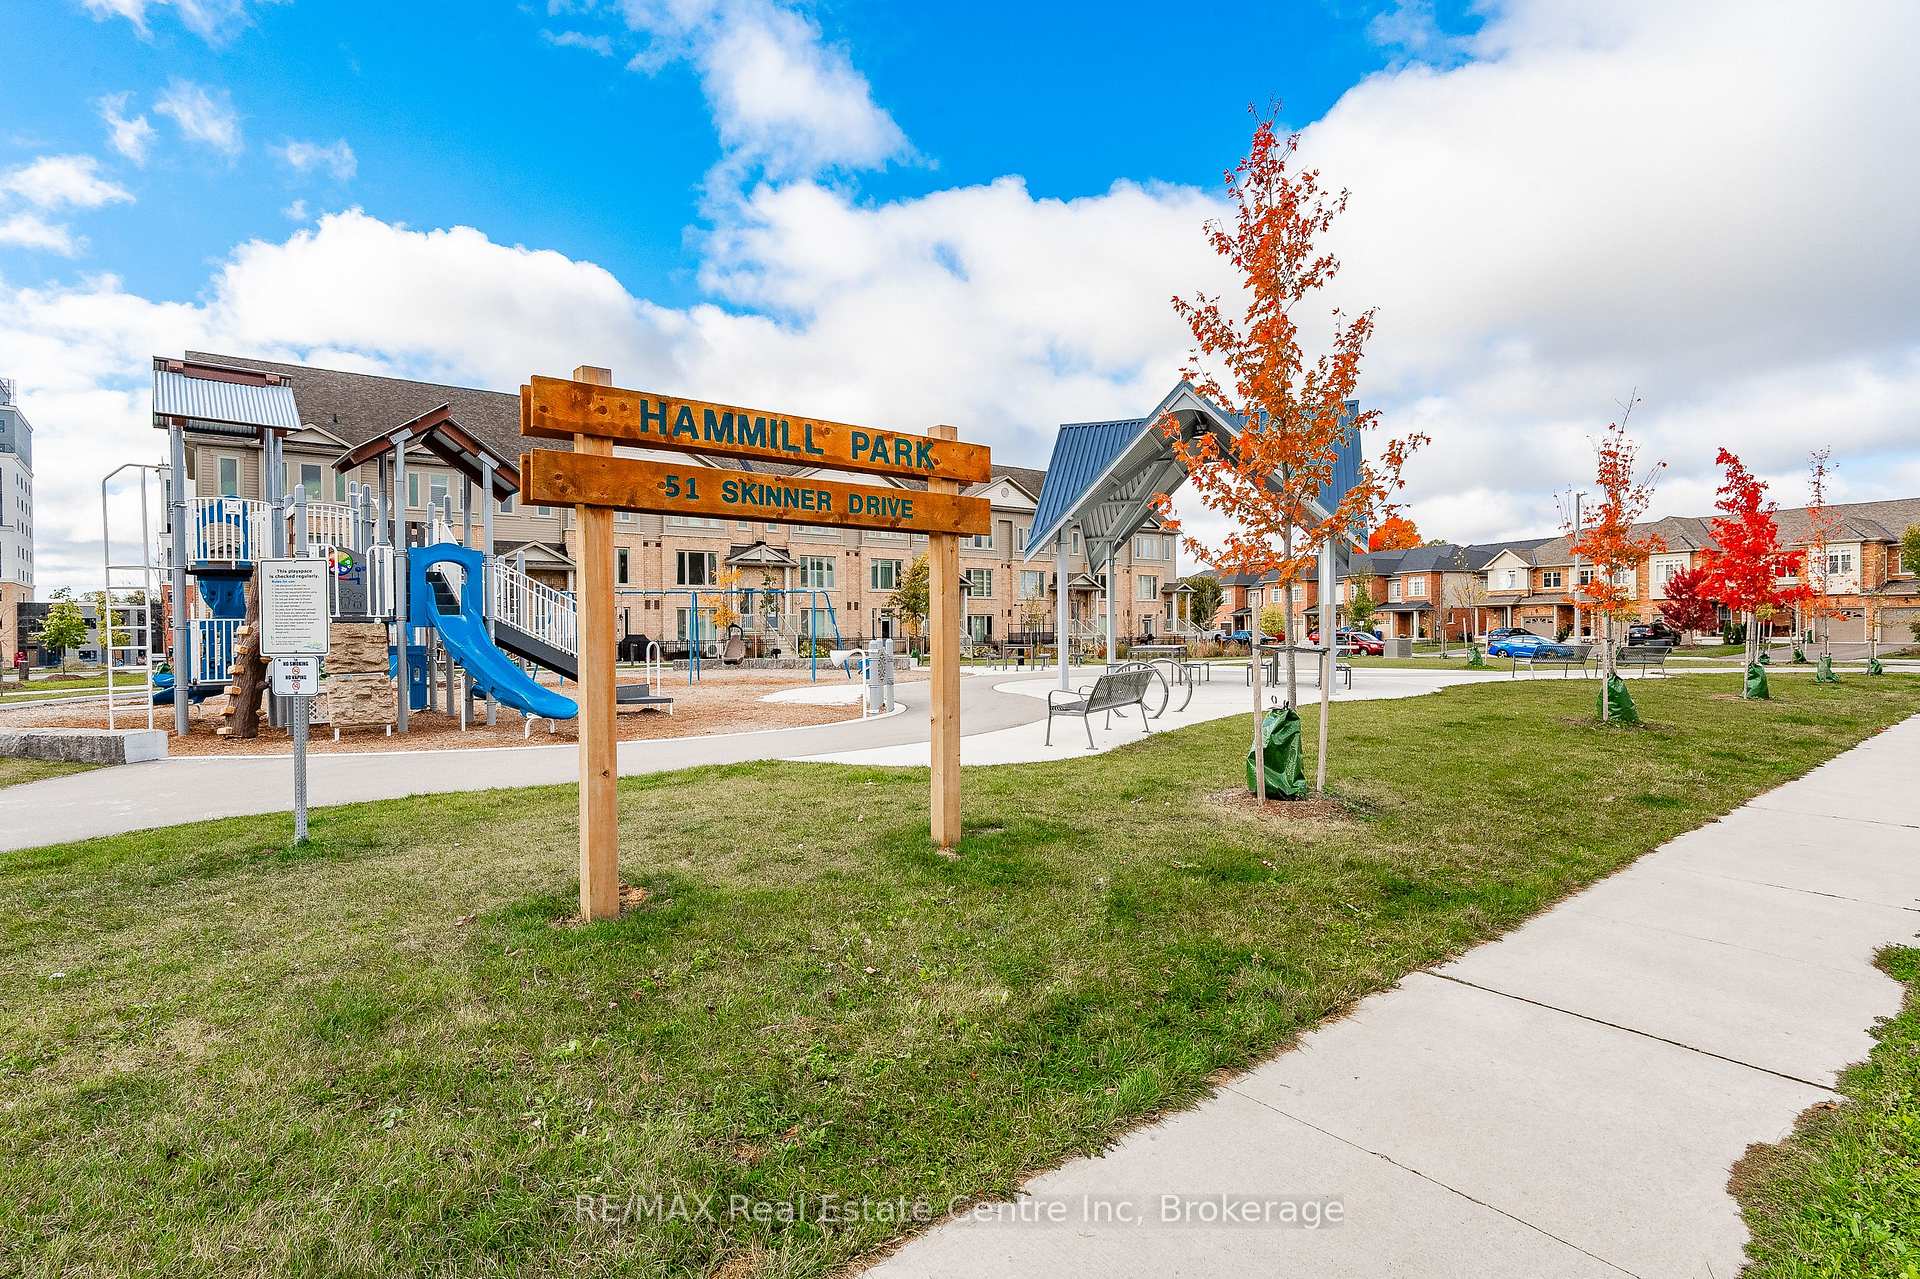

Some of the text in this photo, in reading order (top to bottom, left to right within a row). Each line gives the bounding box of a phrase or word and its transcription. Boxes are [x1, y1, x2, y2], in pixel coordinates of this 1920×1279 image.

[639, 399, 936, 470] HAMMILL PARK
[665, 475, 914, 519] 51 SKINNER DRIVE
